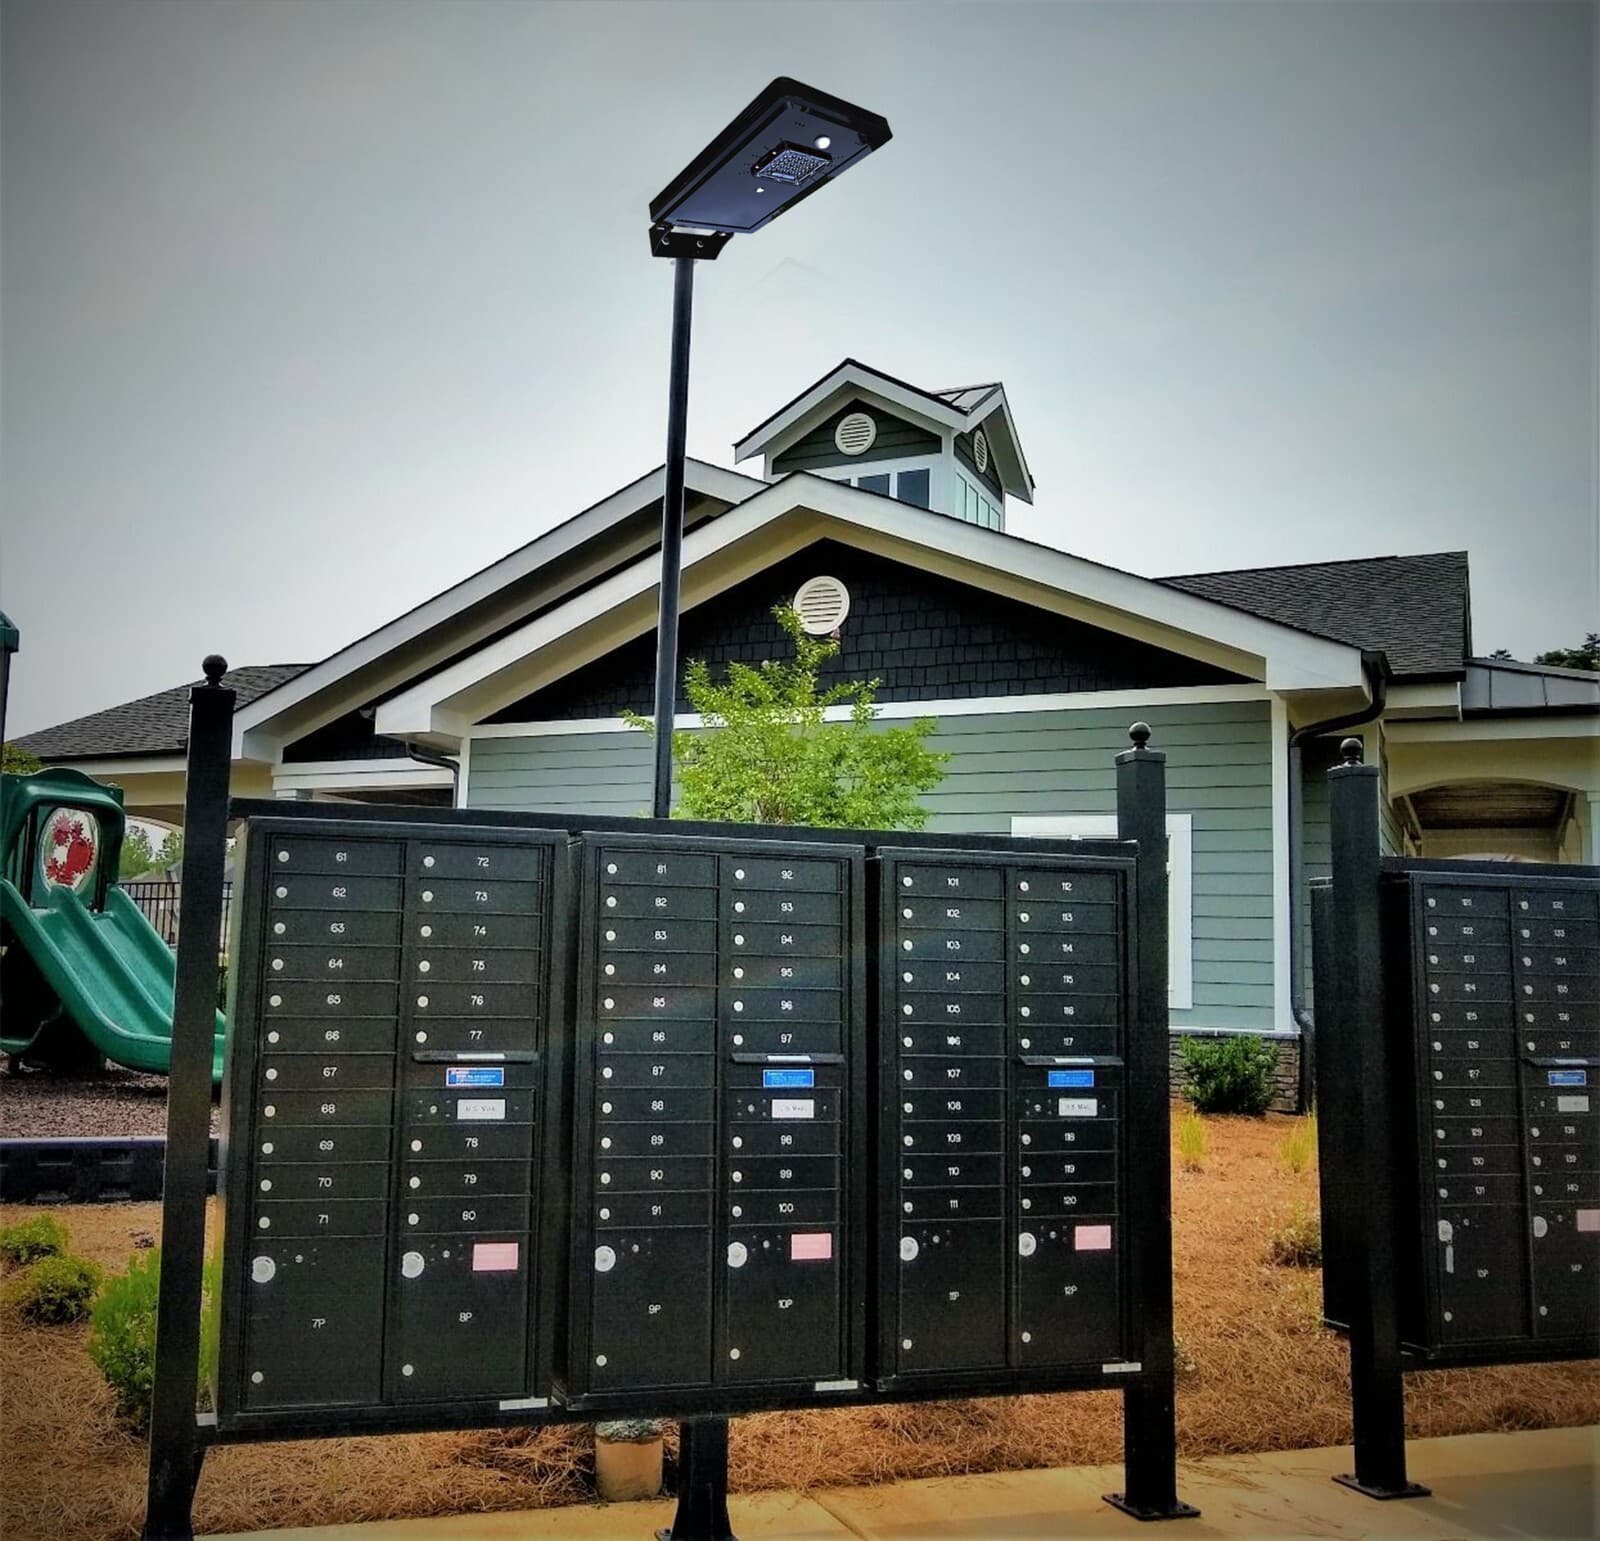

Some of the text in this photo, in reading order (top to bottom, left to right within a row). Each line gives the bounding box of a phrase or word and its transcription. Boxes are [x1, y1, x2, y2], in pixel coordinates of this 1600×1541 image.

[335, 851, 348, 863] 61
[476, 856, 490, 868] 72
[656, 864, 667, 875] 81
[780, 869, 794, 880] 92
[332, 886, 347, 898] 62
[474, 890, 488, 902] 73
[654, 896, 668, 908] 82
[780, 902, 794, 913] 93
[330, 922, 346, 934] 63
[473, 925, 487, 936] 74
[654, 930, 668, 941] 83
[780, 934, 793, 945] 94
[328, 958, 344, 969] 64
[472, 960, 486, 971] 75
[653, 963, 667, 974] 84
[780, 967, 794, 978] 95
[326, 994, 342, 1005] 65
[470, 994, 484, 1006] 76
[652, 997, 666, 1008] 85
[780, 1000, 793, 1011] 96
[324, 1030, 340, 1041] 66
[469, 1030, 483, 1041] 77
[652, 1031, 666, 1042] 86
[780, 1033, 793, 1044] 97
[322, 1066, 338, 1078] 67
[652, 1065, 665, 1076] 87
[320, 1103, 336, 1115] 68
[650, 1100, 664, 1112] 88
[319, 1139, 335, 1151] 69
[464, 1137, 479, 1148] 78
[650, 1134, 664, 1146] 89
[780, 1134, 793, 1146] 98
[463, 1173, 478, 1185] 79
[650, 1169, 664, 1181] 90
[779, 1168, 793, 1180] 99
[317, 1177, 333, 1188] 70
[461, 1210, 477, 1222] 80
[651, 1205, 662, 1216] 91
[318, 1214, 329, 1225] 71
[648, 1304, 662, 1315] 9P
[458, 1311, 473, 1323] 8P
[311, 1318, 327, 1329] 7P
